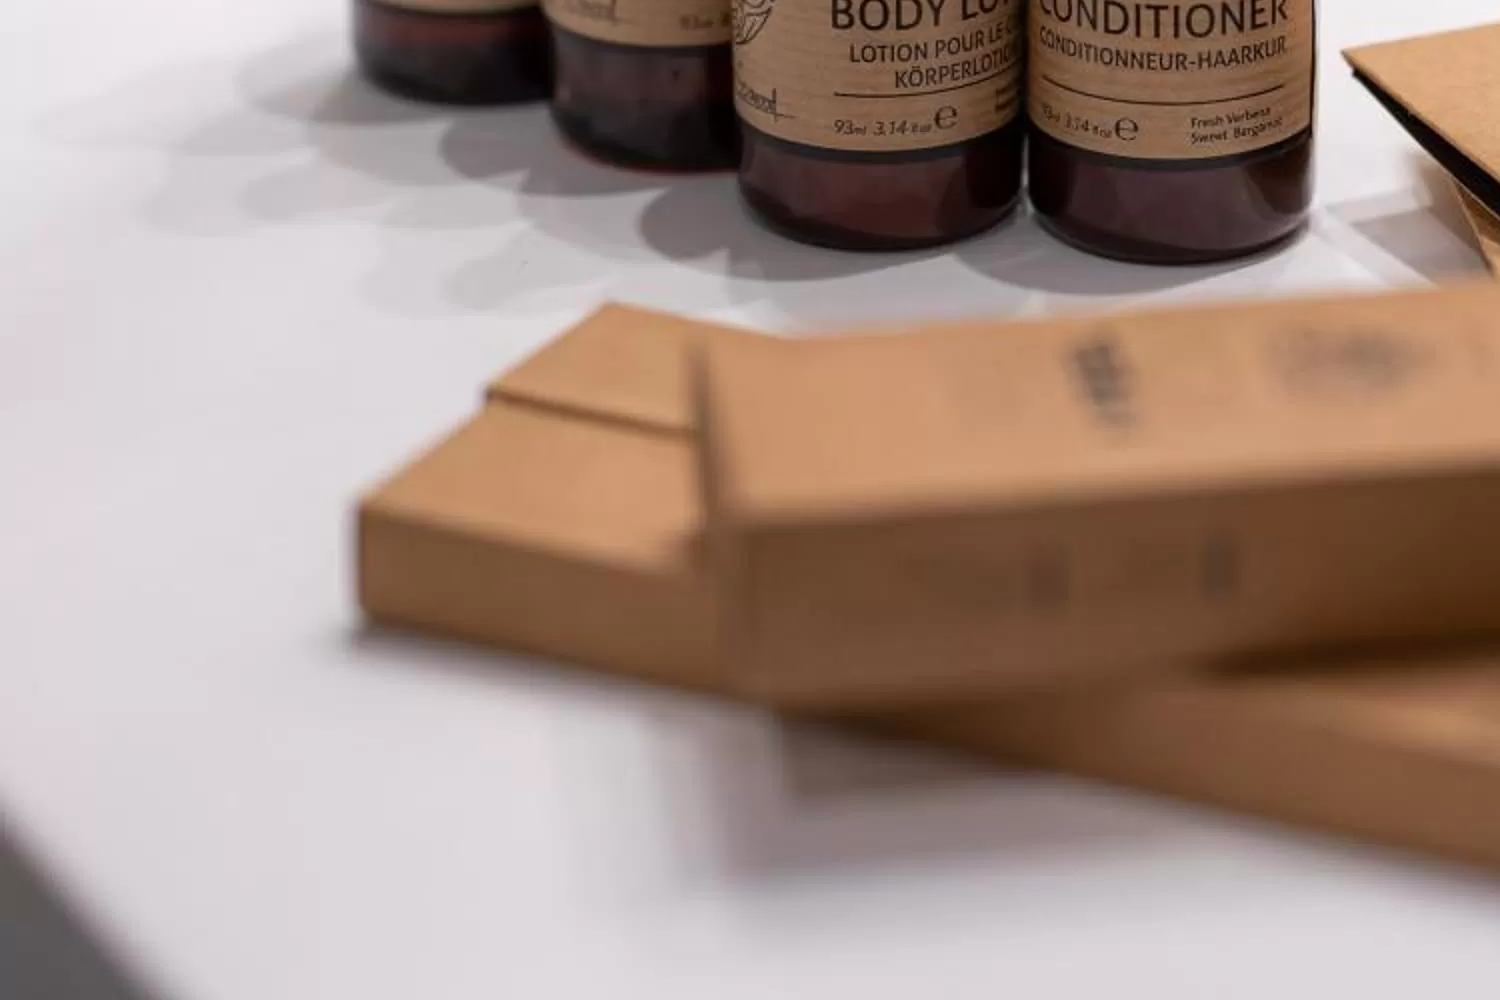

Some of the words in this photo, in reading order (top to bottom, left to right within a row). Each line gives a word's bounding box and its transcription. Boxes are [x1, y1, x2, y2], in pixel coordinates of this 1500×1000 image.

[850, 43, 928, 63] LOTION
[935, 31, 984, 58] POUR
[1039, 25, 1287, 71] CONDITIONNEUR-HAARKUR
